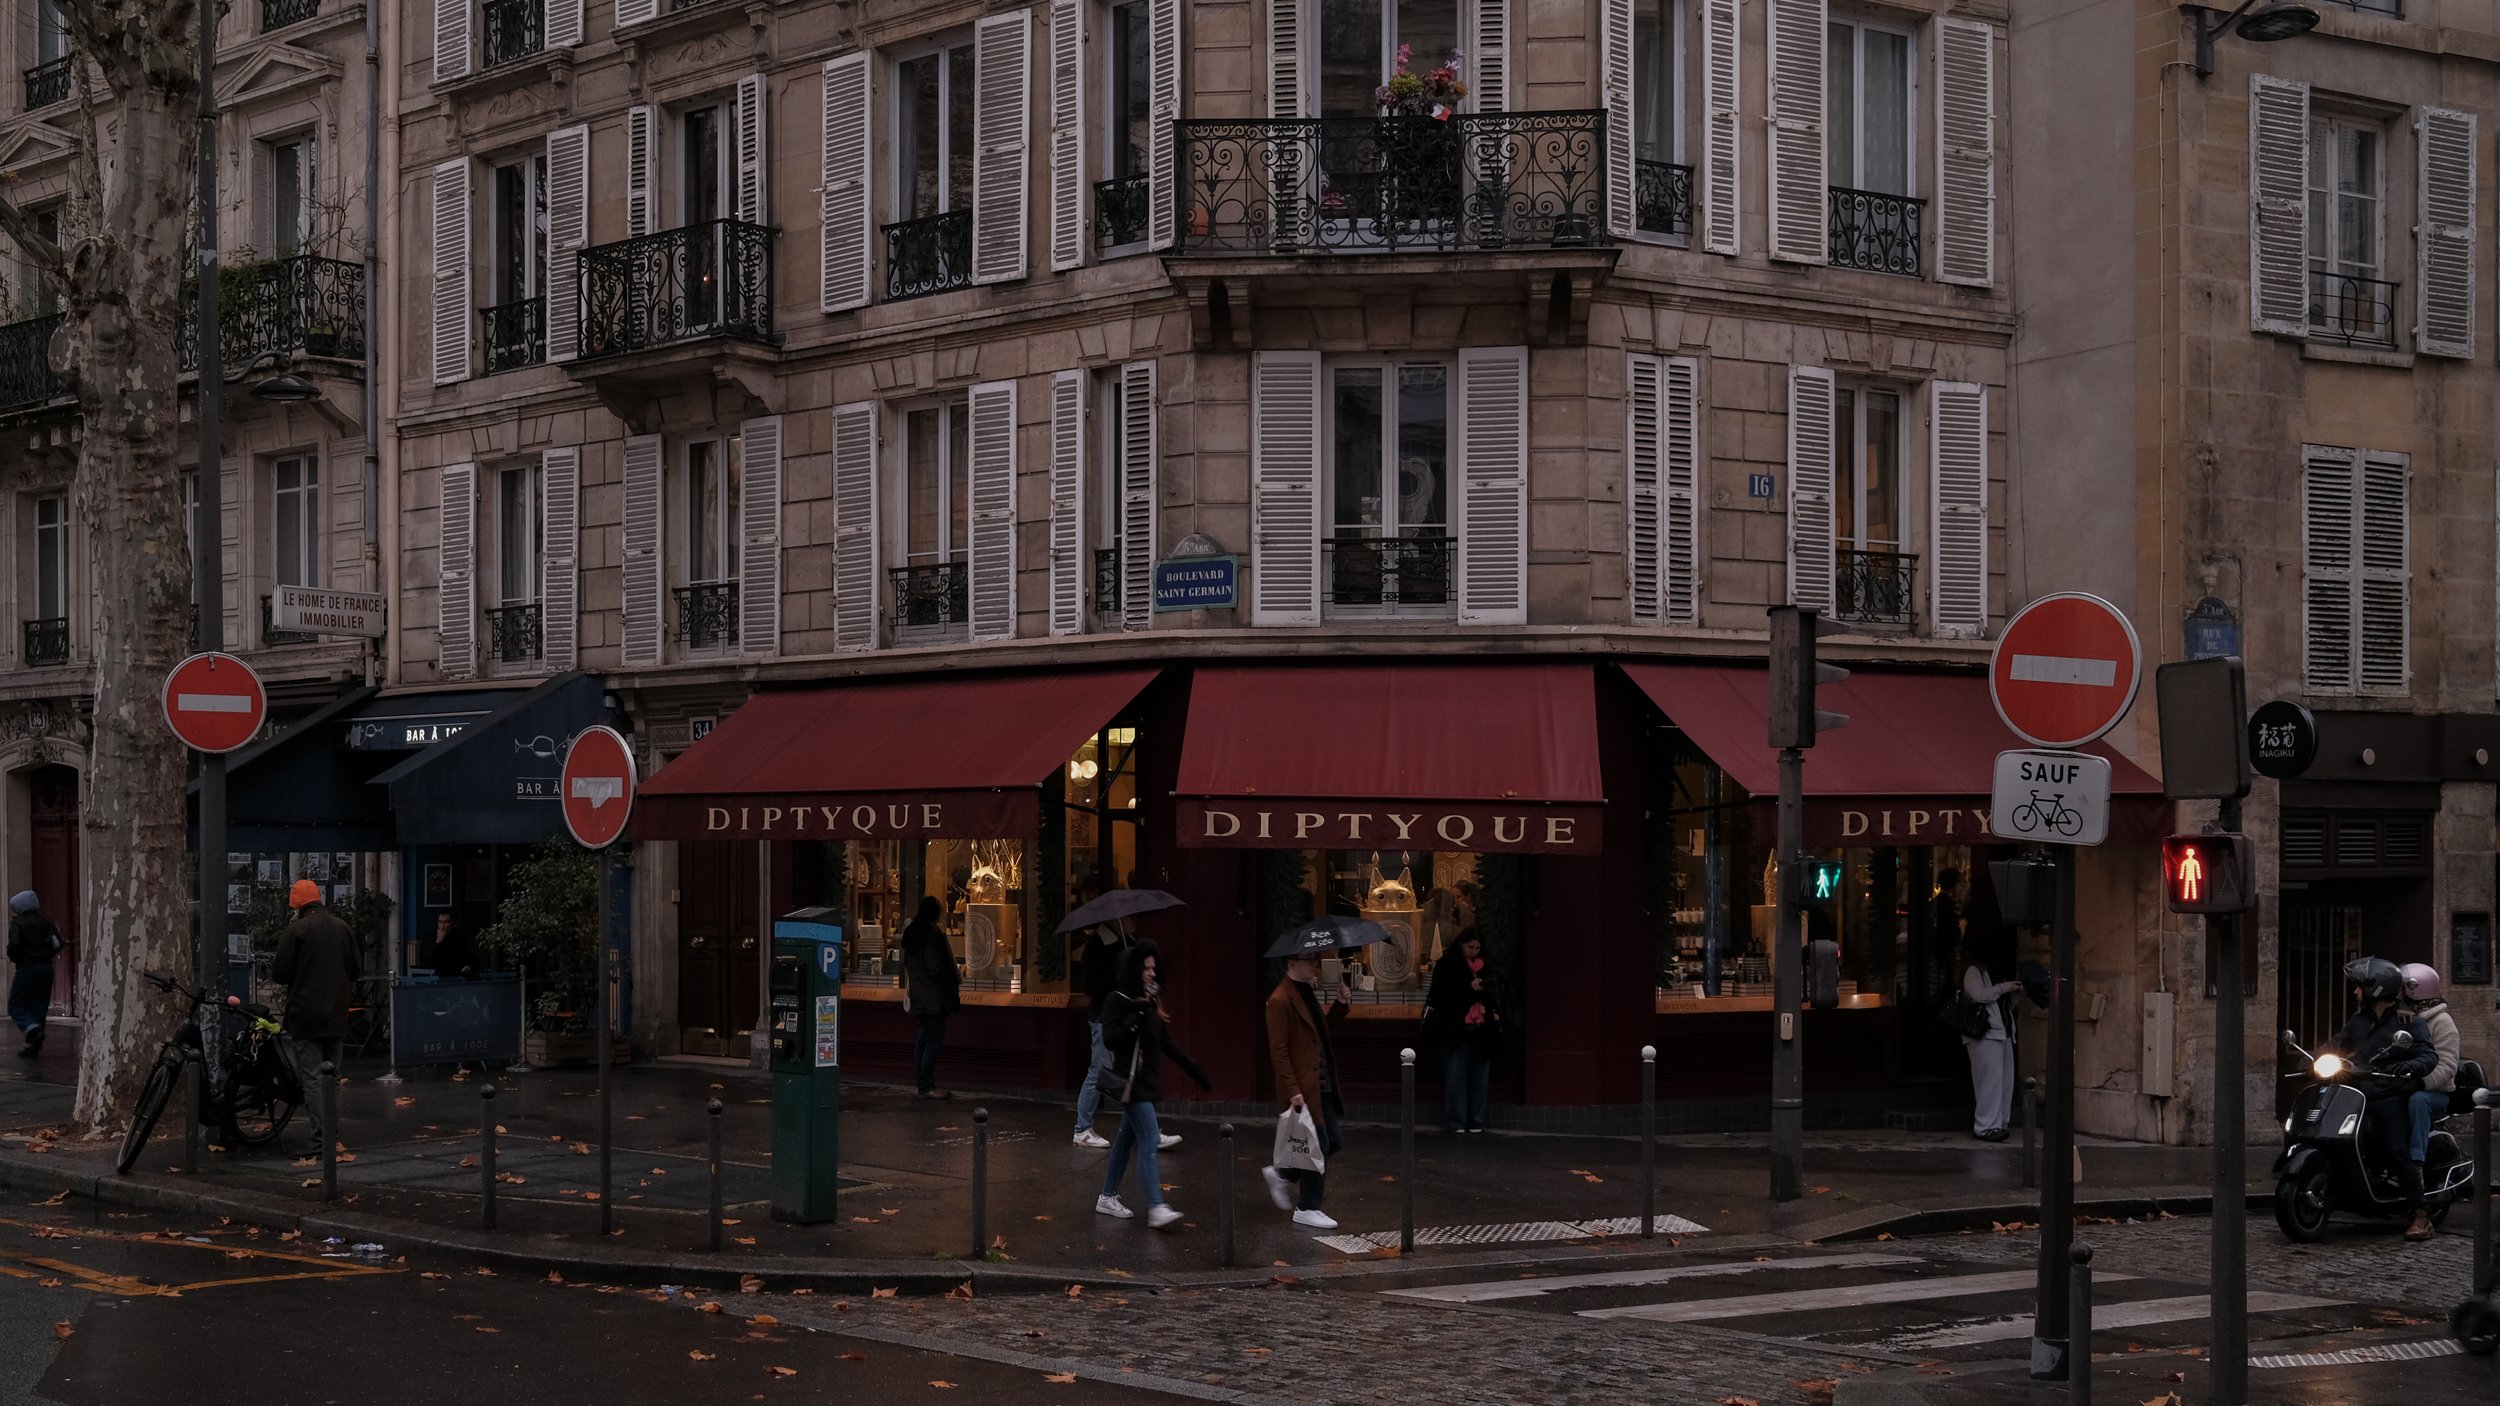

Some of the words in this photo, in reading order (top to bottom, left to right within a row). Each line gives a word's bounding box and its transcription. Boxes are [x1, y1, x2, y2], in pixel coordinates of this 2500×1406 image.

[1753, 475, 1770, 496] 16
[1166, 569, 1224, 582] BOULEVARD
[1157, 588, 1185, 599] SAINT
[1188, 585, 1232, 597] GERMAIN
[284, 592, 294, 606] LE
[298, 594, 325, 608] HOME
[328, 596, 340, 609] DE
[344, 597, 380, 612] FRANCE
[300, 612, 364, 629] IMMOBILIER
[2203, 628, 2222, 639] RUE
[2207, 641, 2218, 650] DE
[406, 729, 425, 741] BAR
[431, 725, 438, 740] À
[695, 722, 710, 739] 34
[2259, 749, 2295, 758] INAGIKU
[2020, 761, 2080, 784] SAUF
[516, 782, 542, 794] BAR
[553, 780, 560, 794] À
[706, 803, 943, 835] DIPTYQUE
[1203, 810, 1576, 847] DIPTYQUE
[823, 947, 836, 973] P
[423, 1043, 442, 1053] BAR
[464, 1039, 489, 1050] IODE
